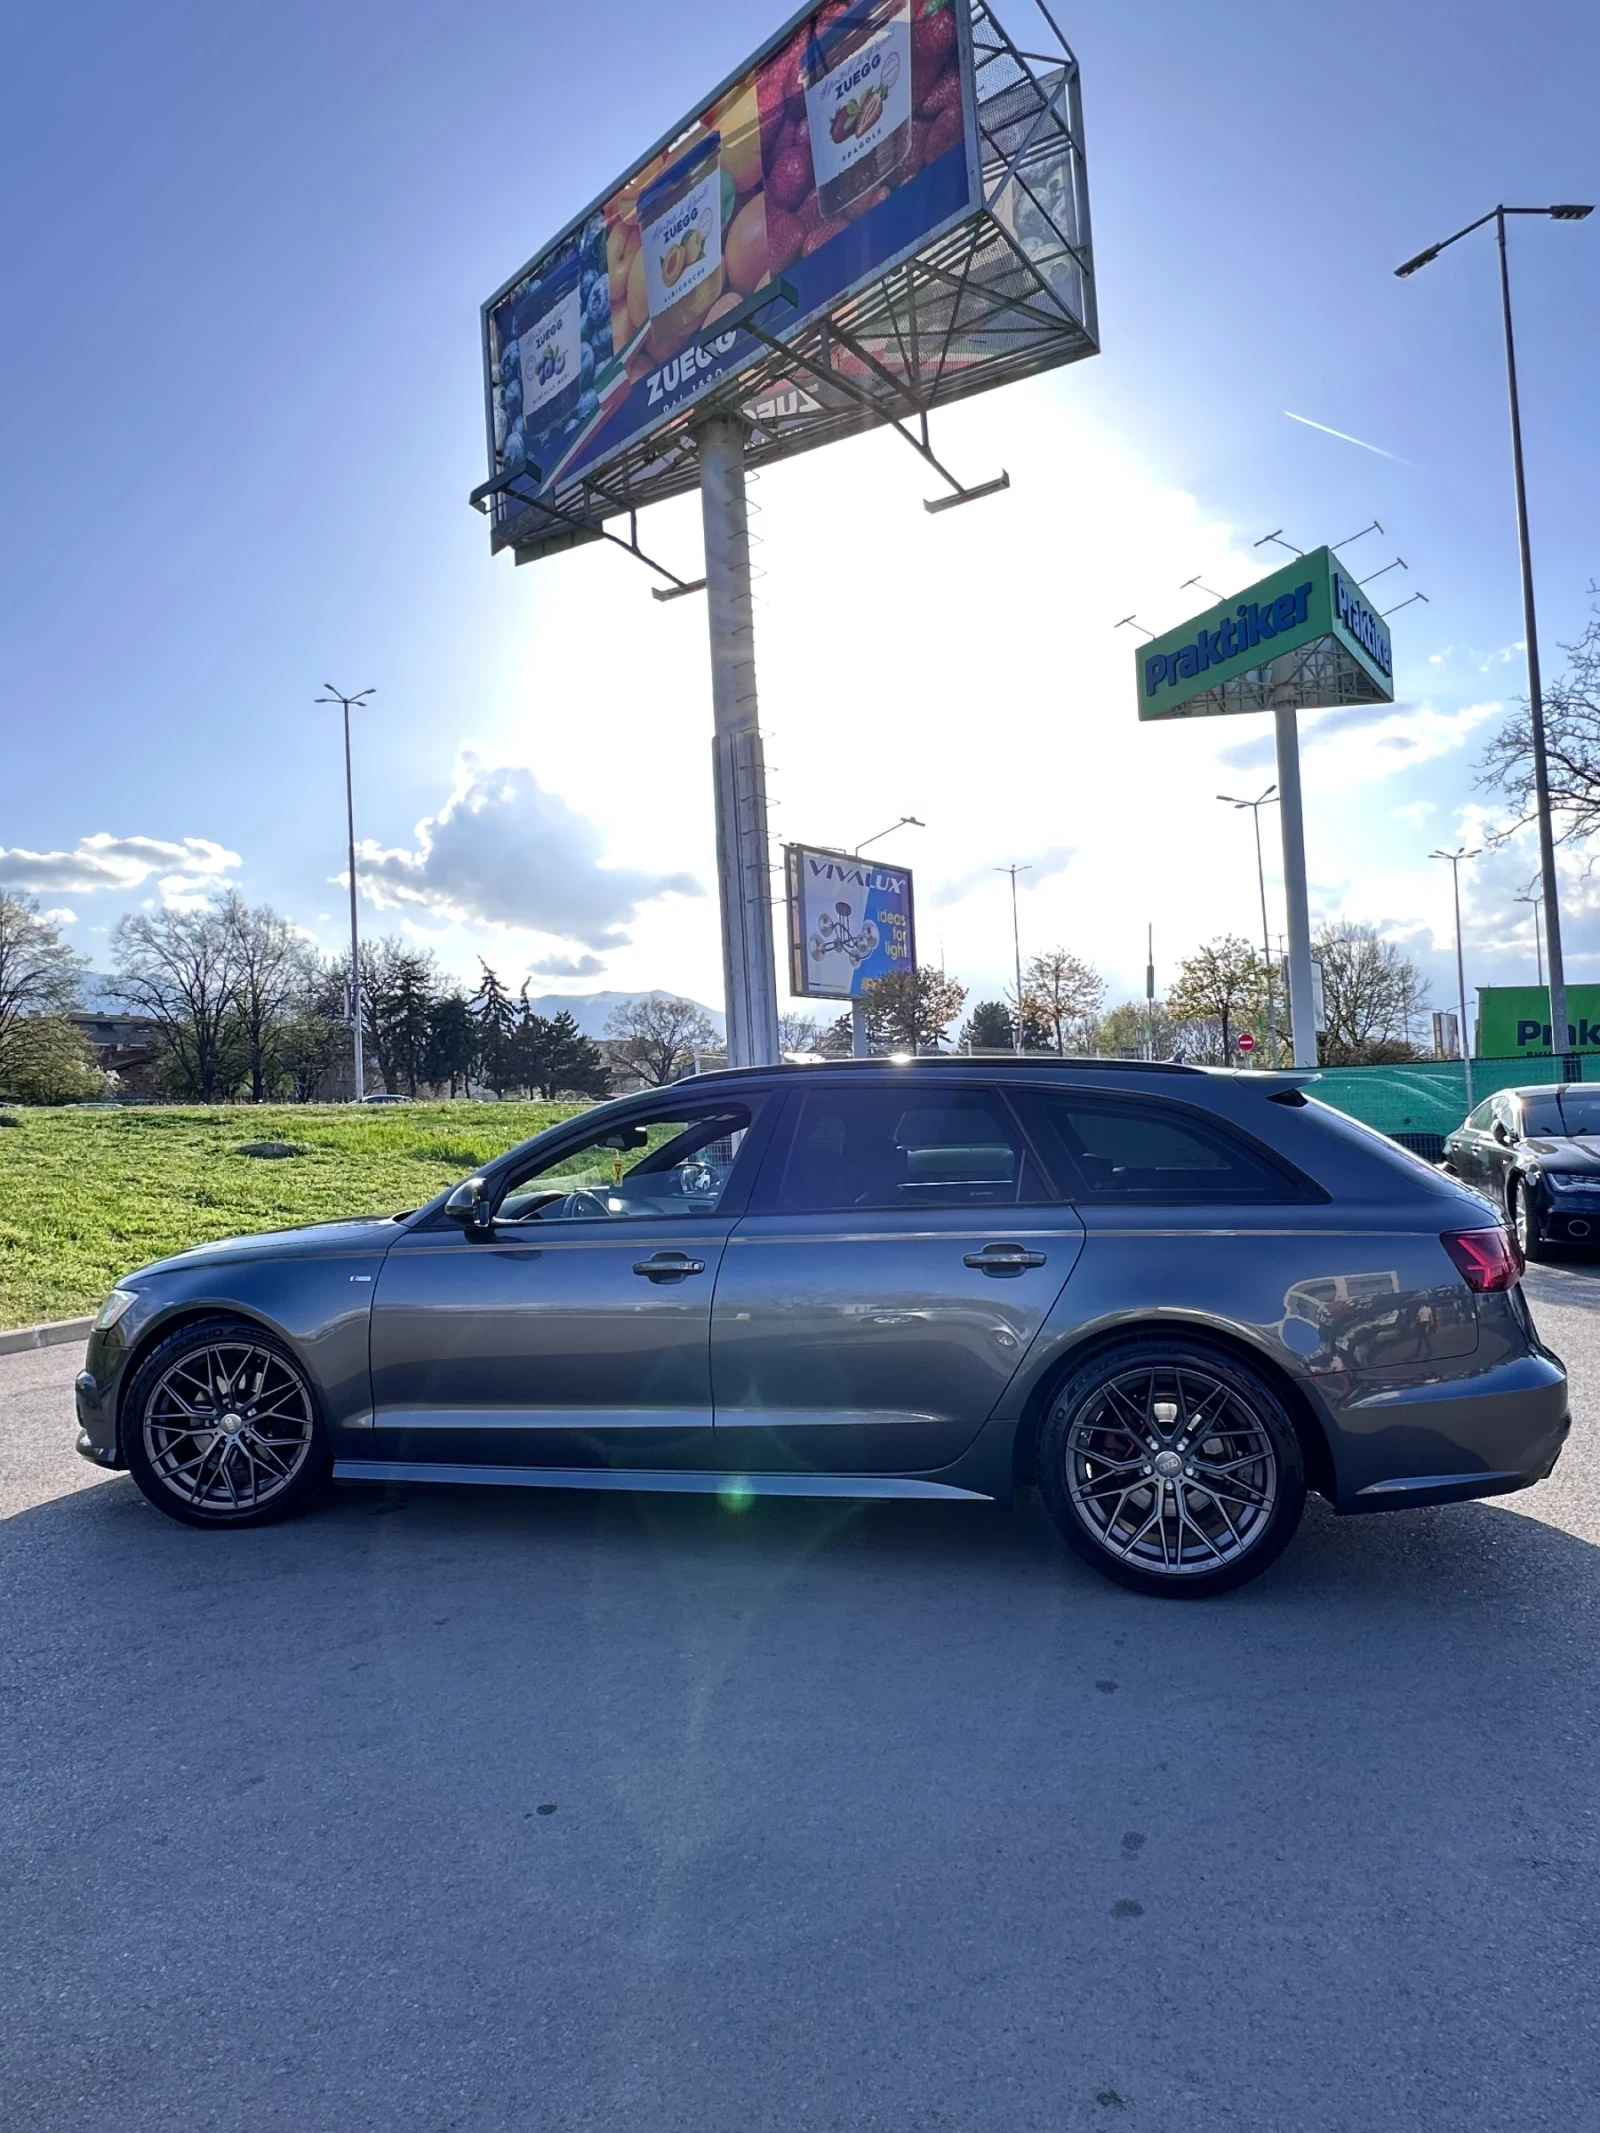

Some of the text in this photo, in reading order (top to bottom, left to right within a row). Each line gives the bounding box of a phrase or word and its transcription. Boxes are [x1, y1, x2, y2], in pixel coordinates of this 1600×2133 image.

[835, 53, 882, 101] ZUEGG
[842, 126, 882, 162] FRAGOLE
[663, 207, 699, 245] ZUEGG
[535, 318, 563, 350] ZUEGG
[646, 330, 737, 407] ZUEGG
[1145, 581, 1312, 697] Praktiker
[809, 859, 904, 894] VIVALUX
[877, 908, 906, 926] ideas
[893, 926, 906, 942] for
[885, 942, 907, 960] light
